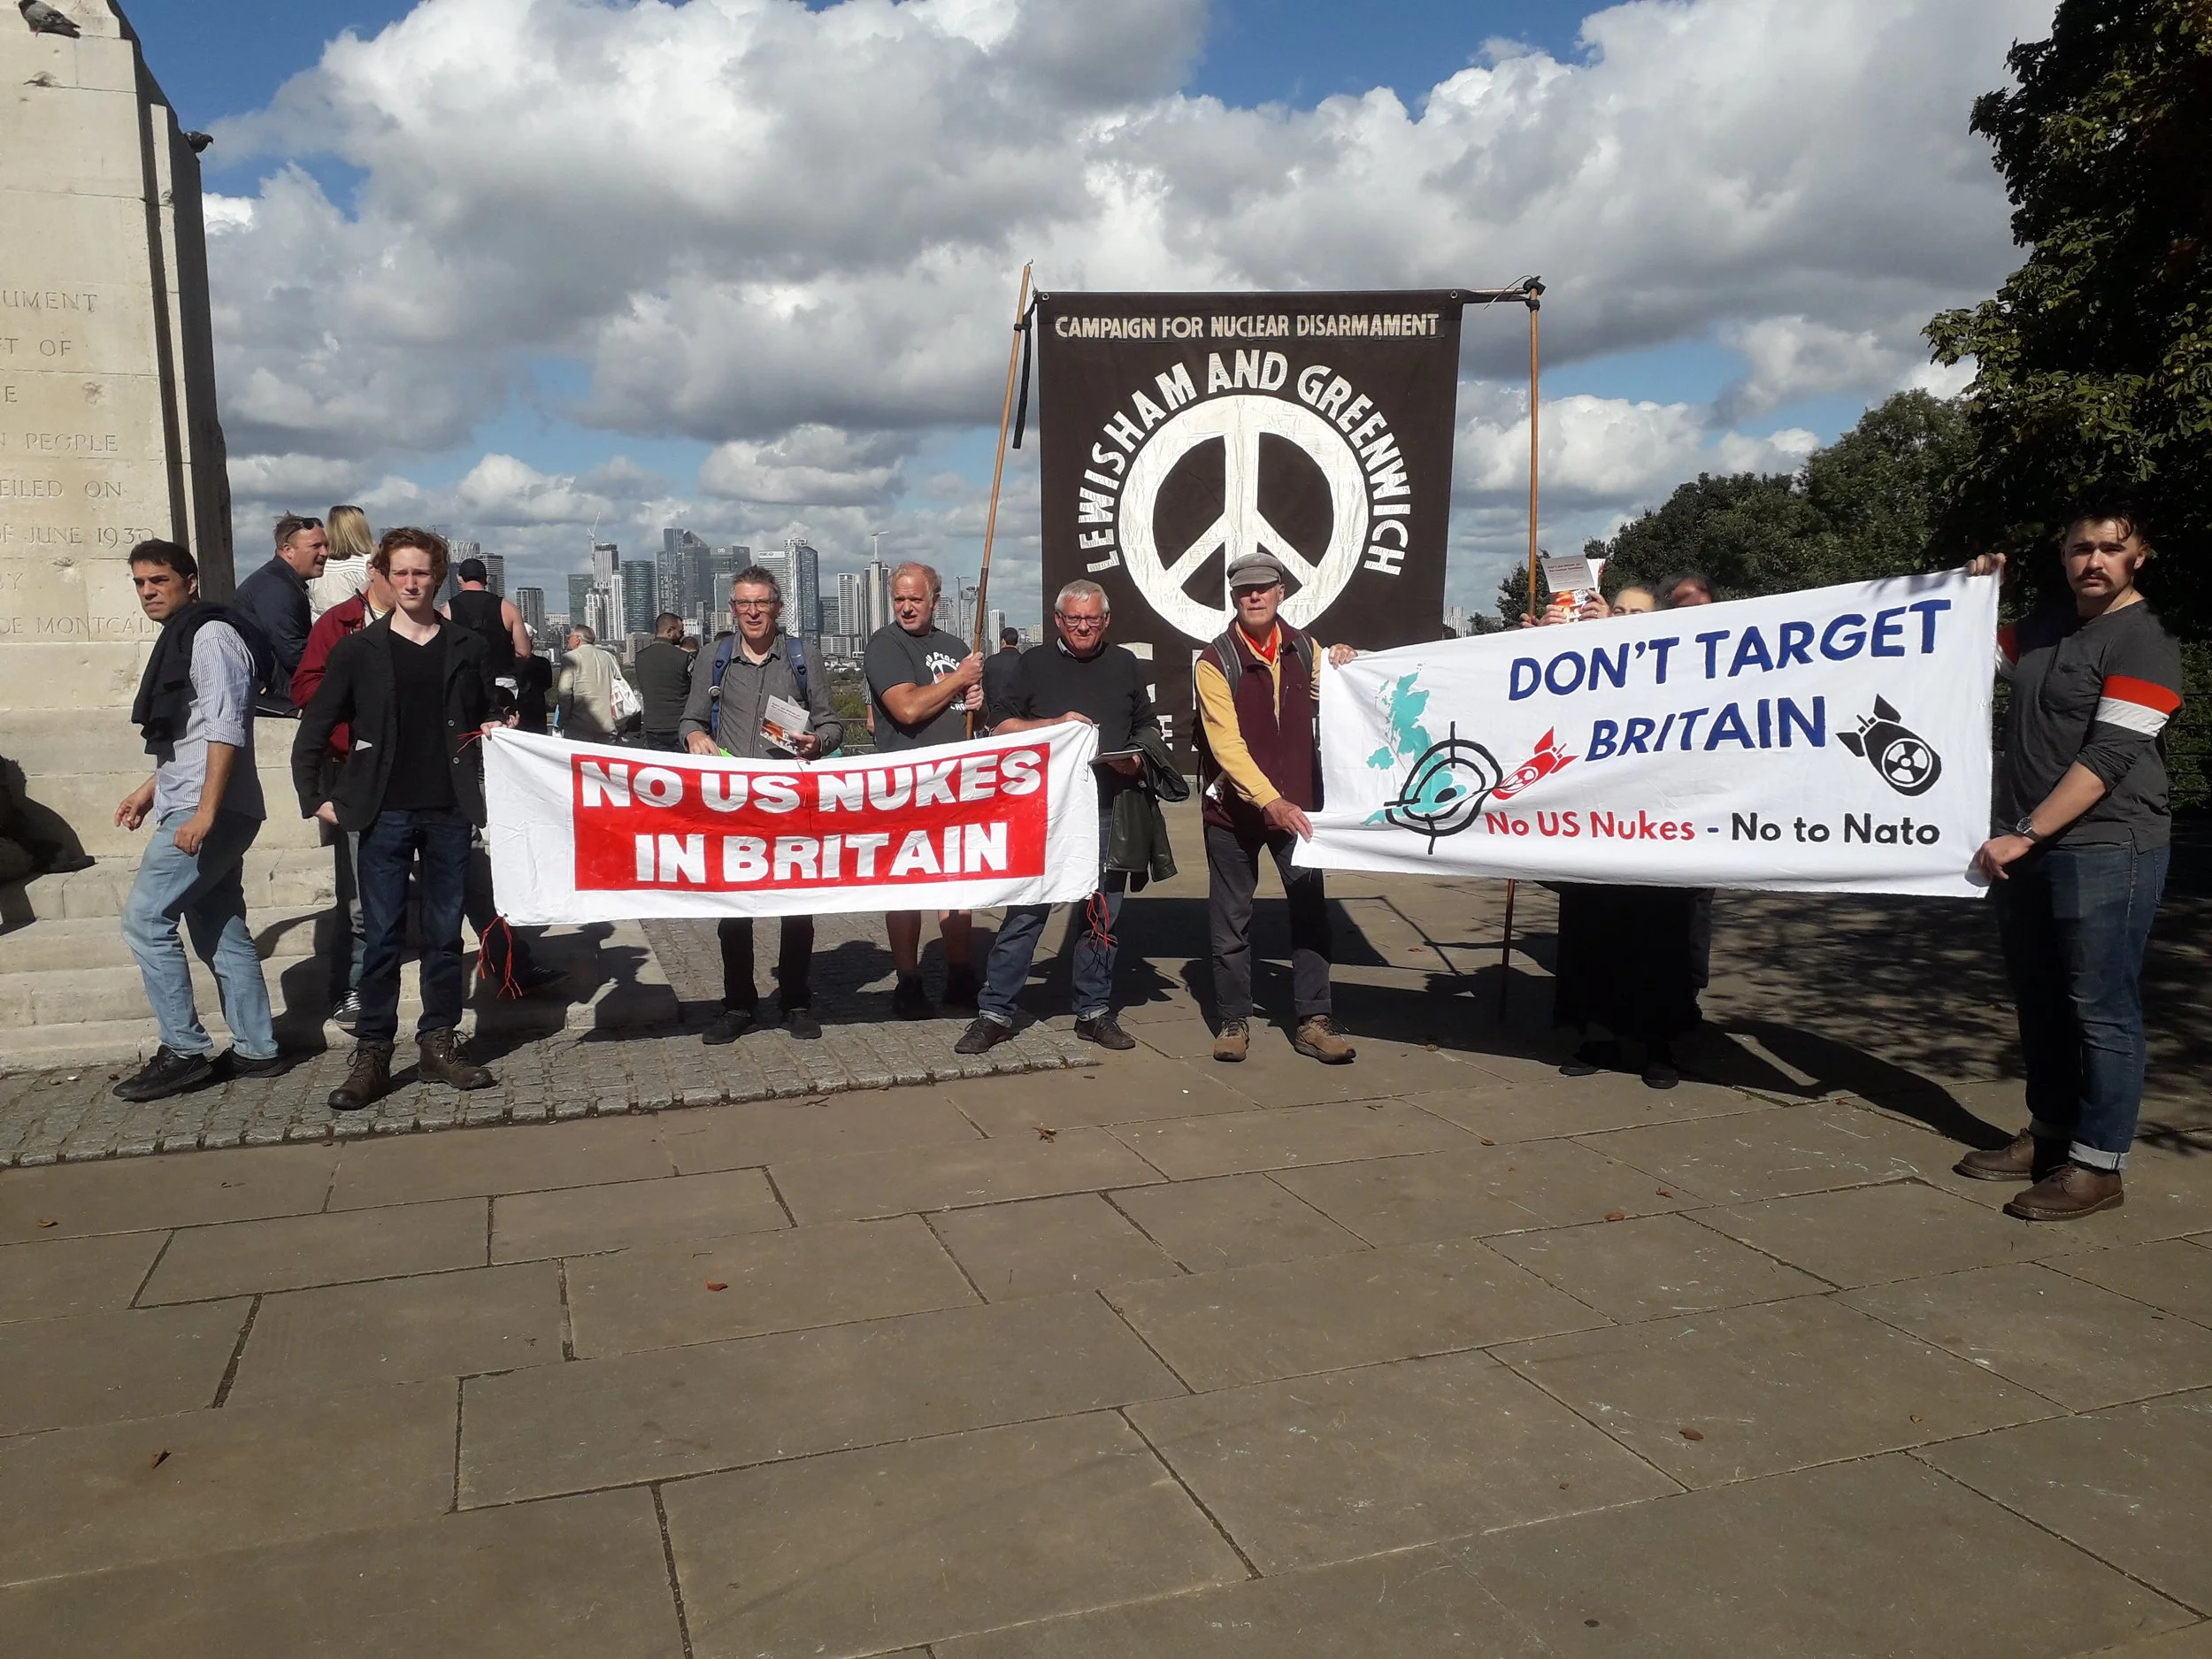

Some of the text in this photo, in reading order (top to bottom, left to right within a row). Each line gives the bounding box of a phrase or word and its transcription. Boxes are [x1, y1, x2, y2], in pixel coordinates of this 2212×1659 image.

[1055, 313, 1440, 339] CAMPAIGN FOR NUCLEAR DISARMAMENT
[40, 339, 72, 356] OF
[26, 433, 119, 451] PEOPLE
[1078, 349, 1412, 577] LEWISHAM AND GREENWICH
[84, 480, 122, 497] ON
[27, 526, 82, 544] JUNE
[1509, 599, 1952, 702] DON'T TARGET
[1585, 695, 1825, 762] BRITAIN
[580, 749, 1042, 814] NO US NUKES
[1484, 811, 1530, 836] No
[1537, 810, 1580, 838] US
[1590, 810, 1695, 841] Nukes
[1732, 812, 1782, 842] No
[1793, 817, 1831, 843] to
[1844, 812, 1941, 846] Nato
[634, 822, 1008, 884] IN BRITAIN
